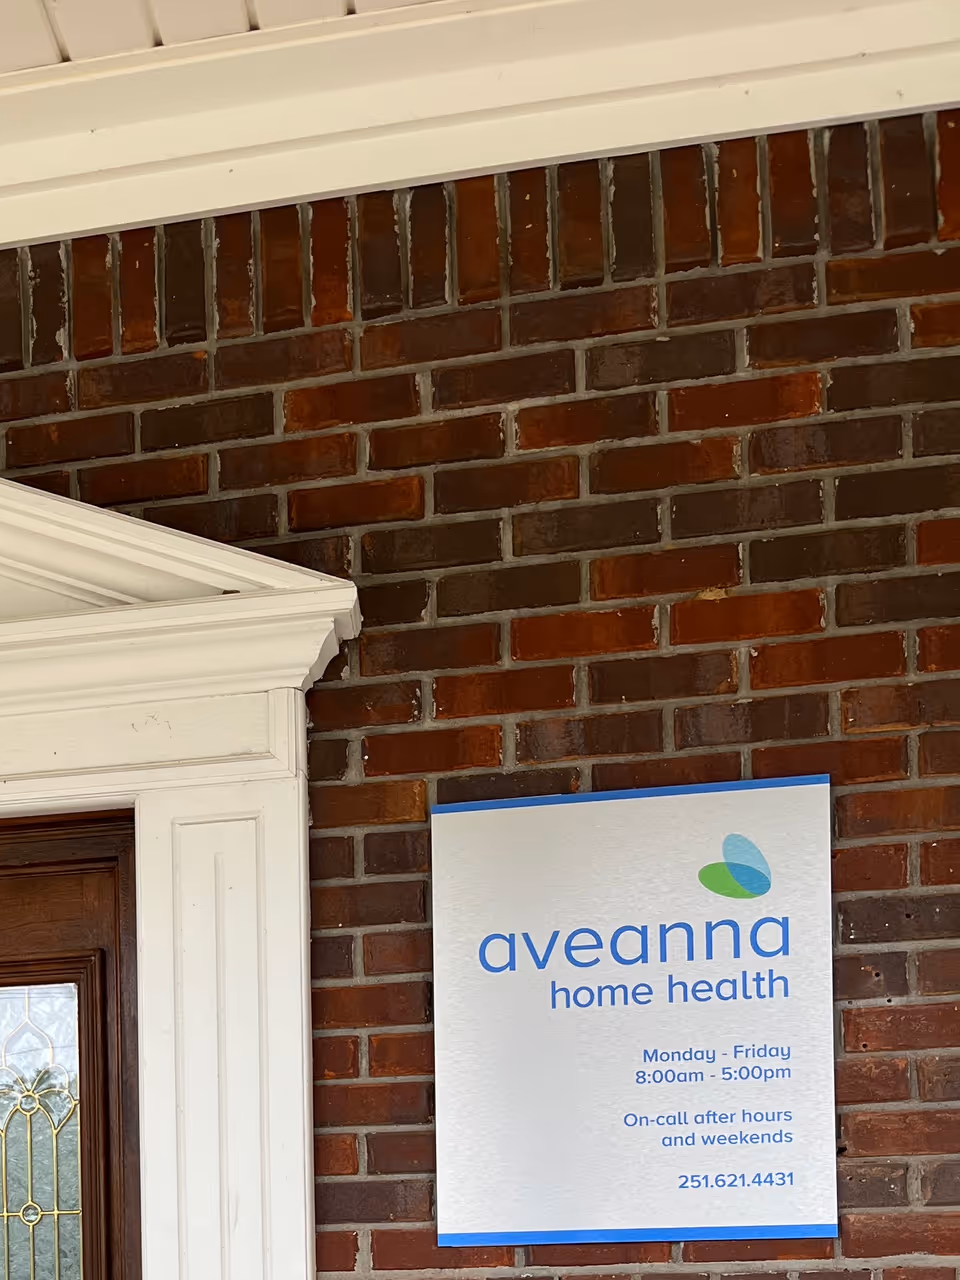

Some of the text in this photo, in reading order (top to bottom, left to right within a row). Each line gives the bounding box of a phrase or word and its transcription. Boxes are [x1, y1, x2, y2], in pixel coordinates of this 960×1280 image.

[478, 915, 790, 974] aveanna
[551, 969, 790, 1010] home health
[642, 1046, 717, 1065] Monday
[733, 1043, 792, 1061] Friday
[635, 1068, 704, 1085] 8:00am
[721, 1065, 792, 1083] 5:00pm
[623, 1107, 793, 1128] On-call after hours
[661, 1129, 793, 1147] and weekends
[678, 1171, 795, 1190] 251.621.4431
